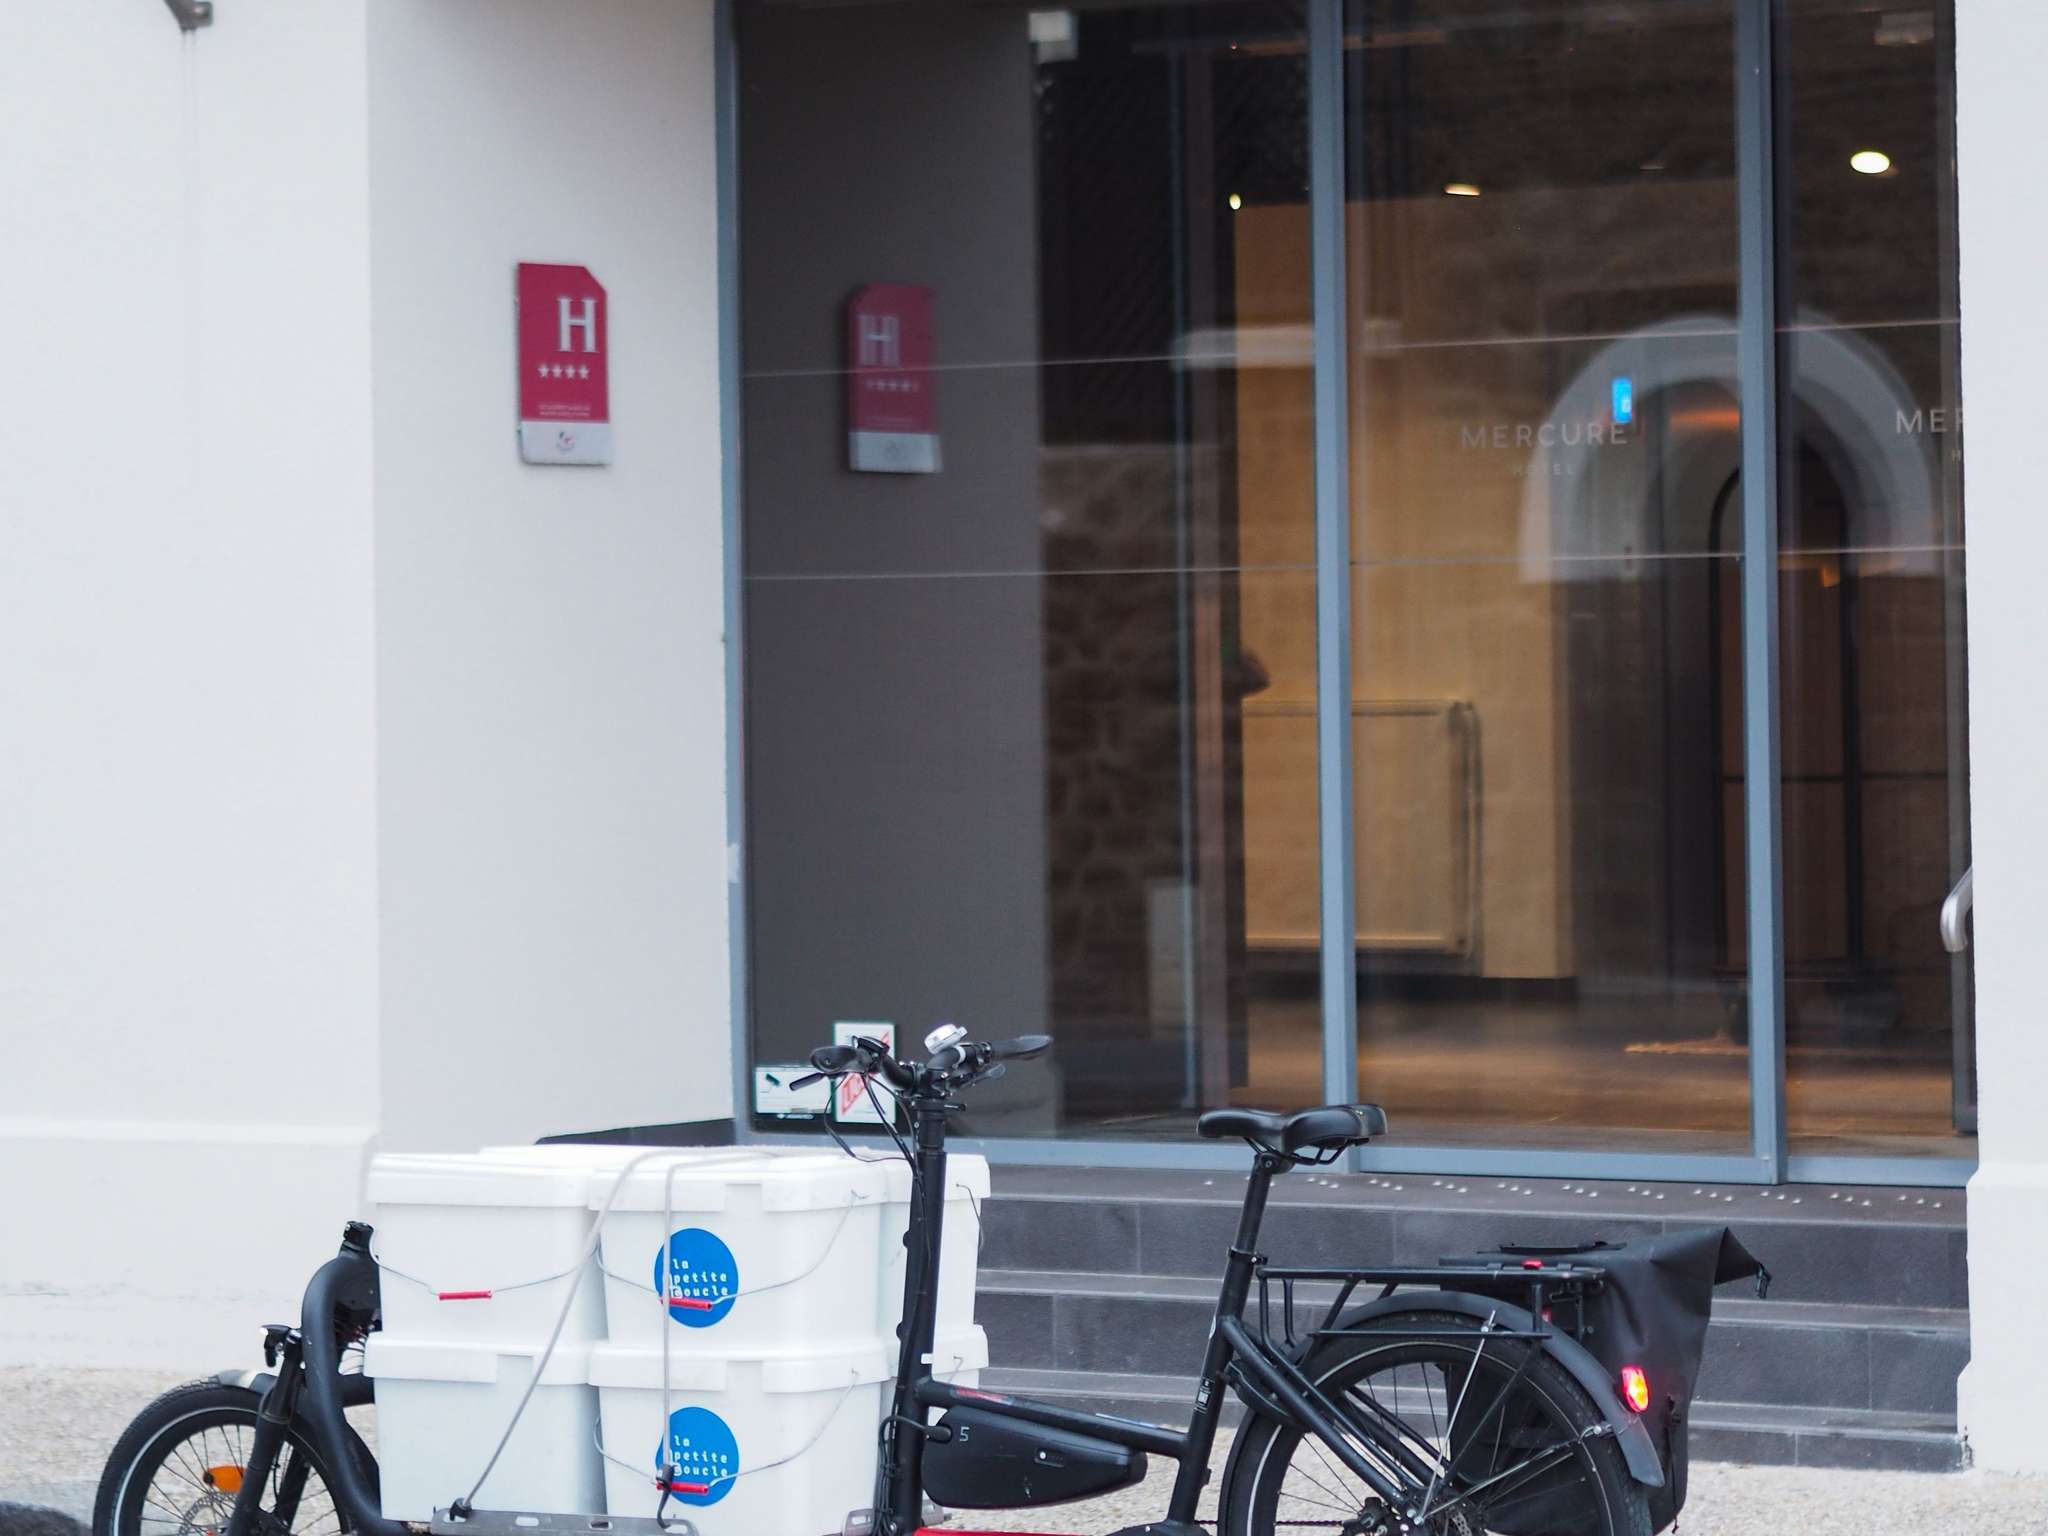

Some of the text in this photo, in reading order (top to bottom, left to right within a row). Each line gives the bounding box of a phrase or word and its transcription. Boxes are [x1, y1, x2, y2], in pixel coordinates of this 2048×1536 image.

[556, 297, 599, 353] H
[1461, 422, 1628, 449] MERCURE
[672, 1258, 689, 1270] la
[673, 1271, 728, 1285] petite
[674, 1434, 691, 1447] la
[674, 1450, 728, 1464] petite
